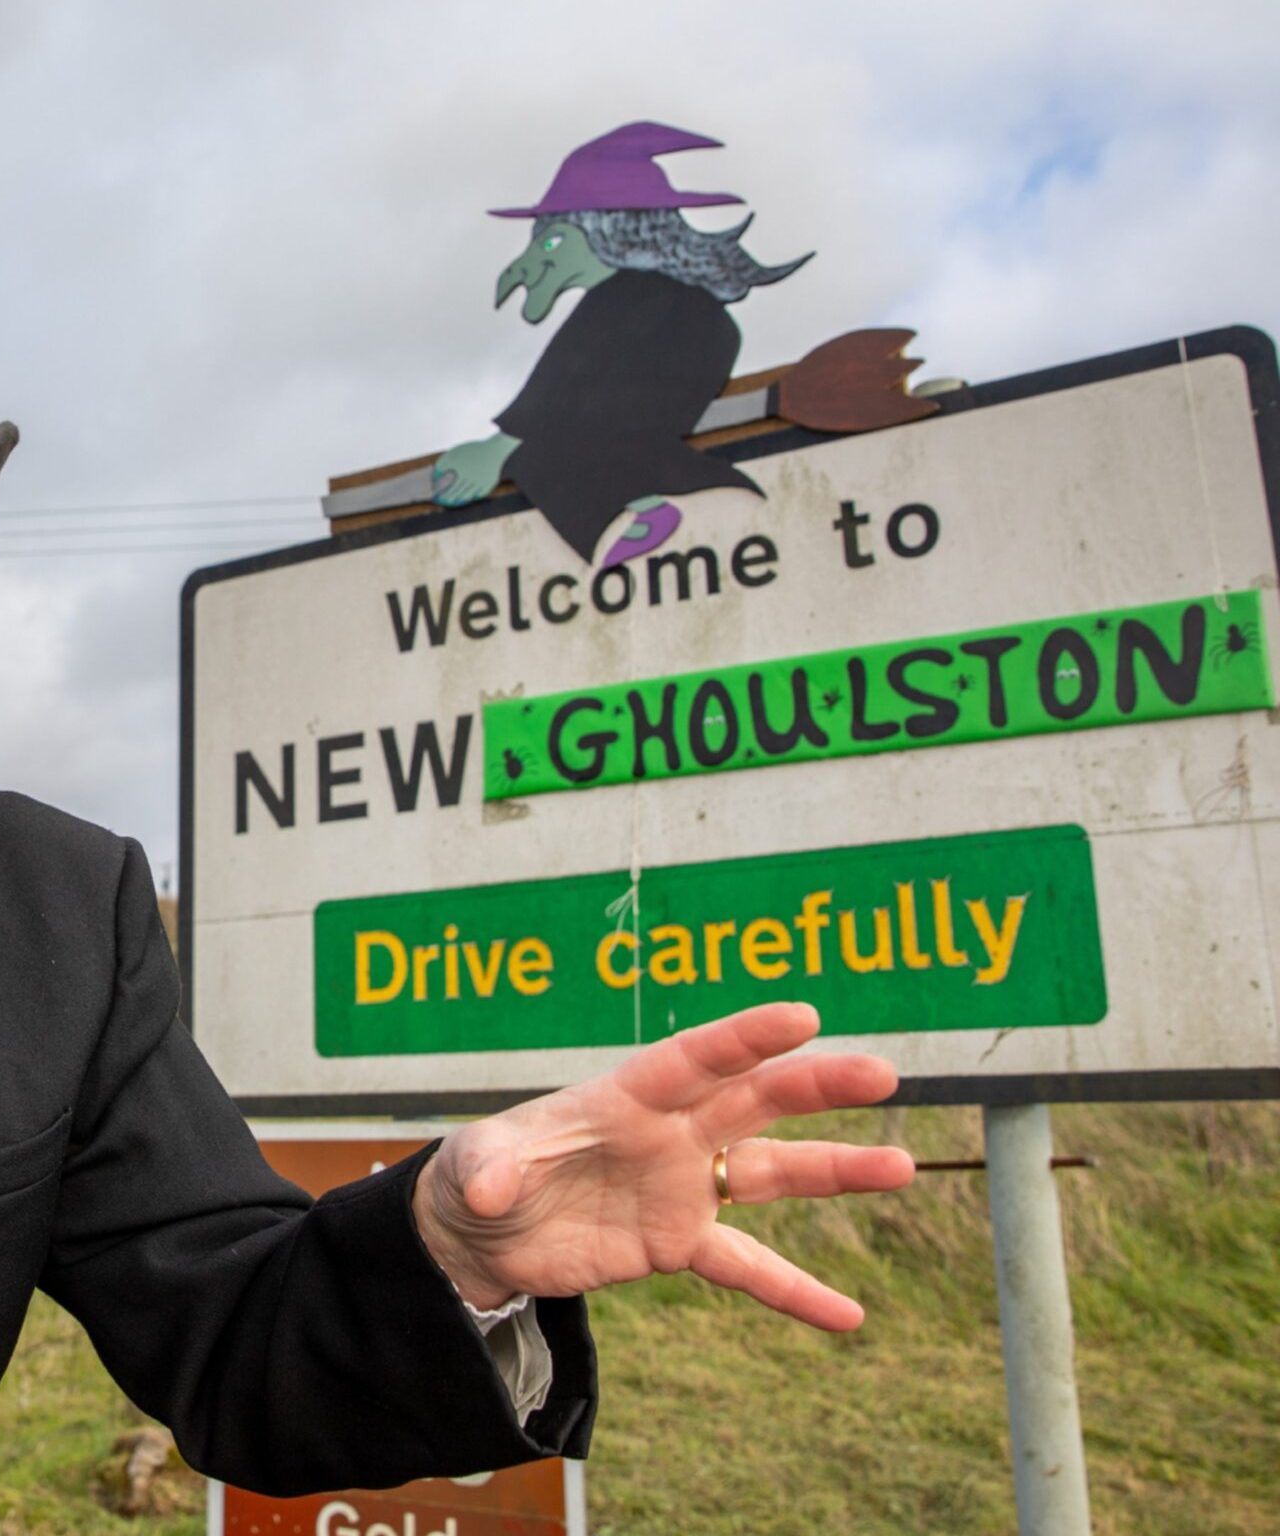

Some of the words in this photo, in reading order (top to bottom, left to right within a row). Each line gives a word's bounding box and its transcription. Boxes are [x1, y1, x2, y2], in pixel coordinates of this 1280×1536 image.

[386, 534, 779, 653] Welcome
[833, 500, 940, 569] to
[233, 715, 473, 835] NEW
[547, 604, 1206, 785] GHOULSTON
[355, 925, 553, 1004] Drive
[595, 878, 1027, 990] carefully
